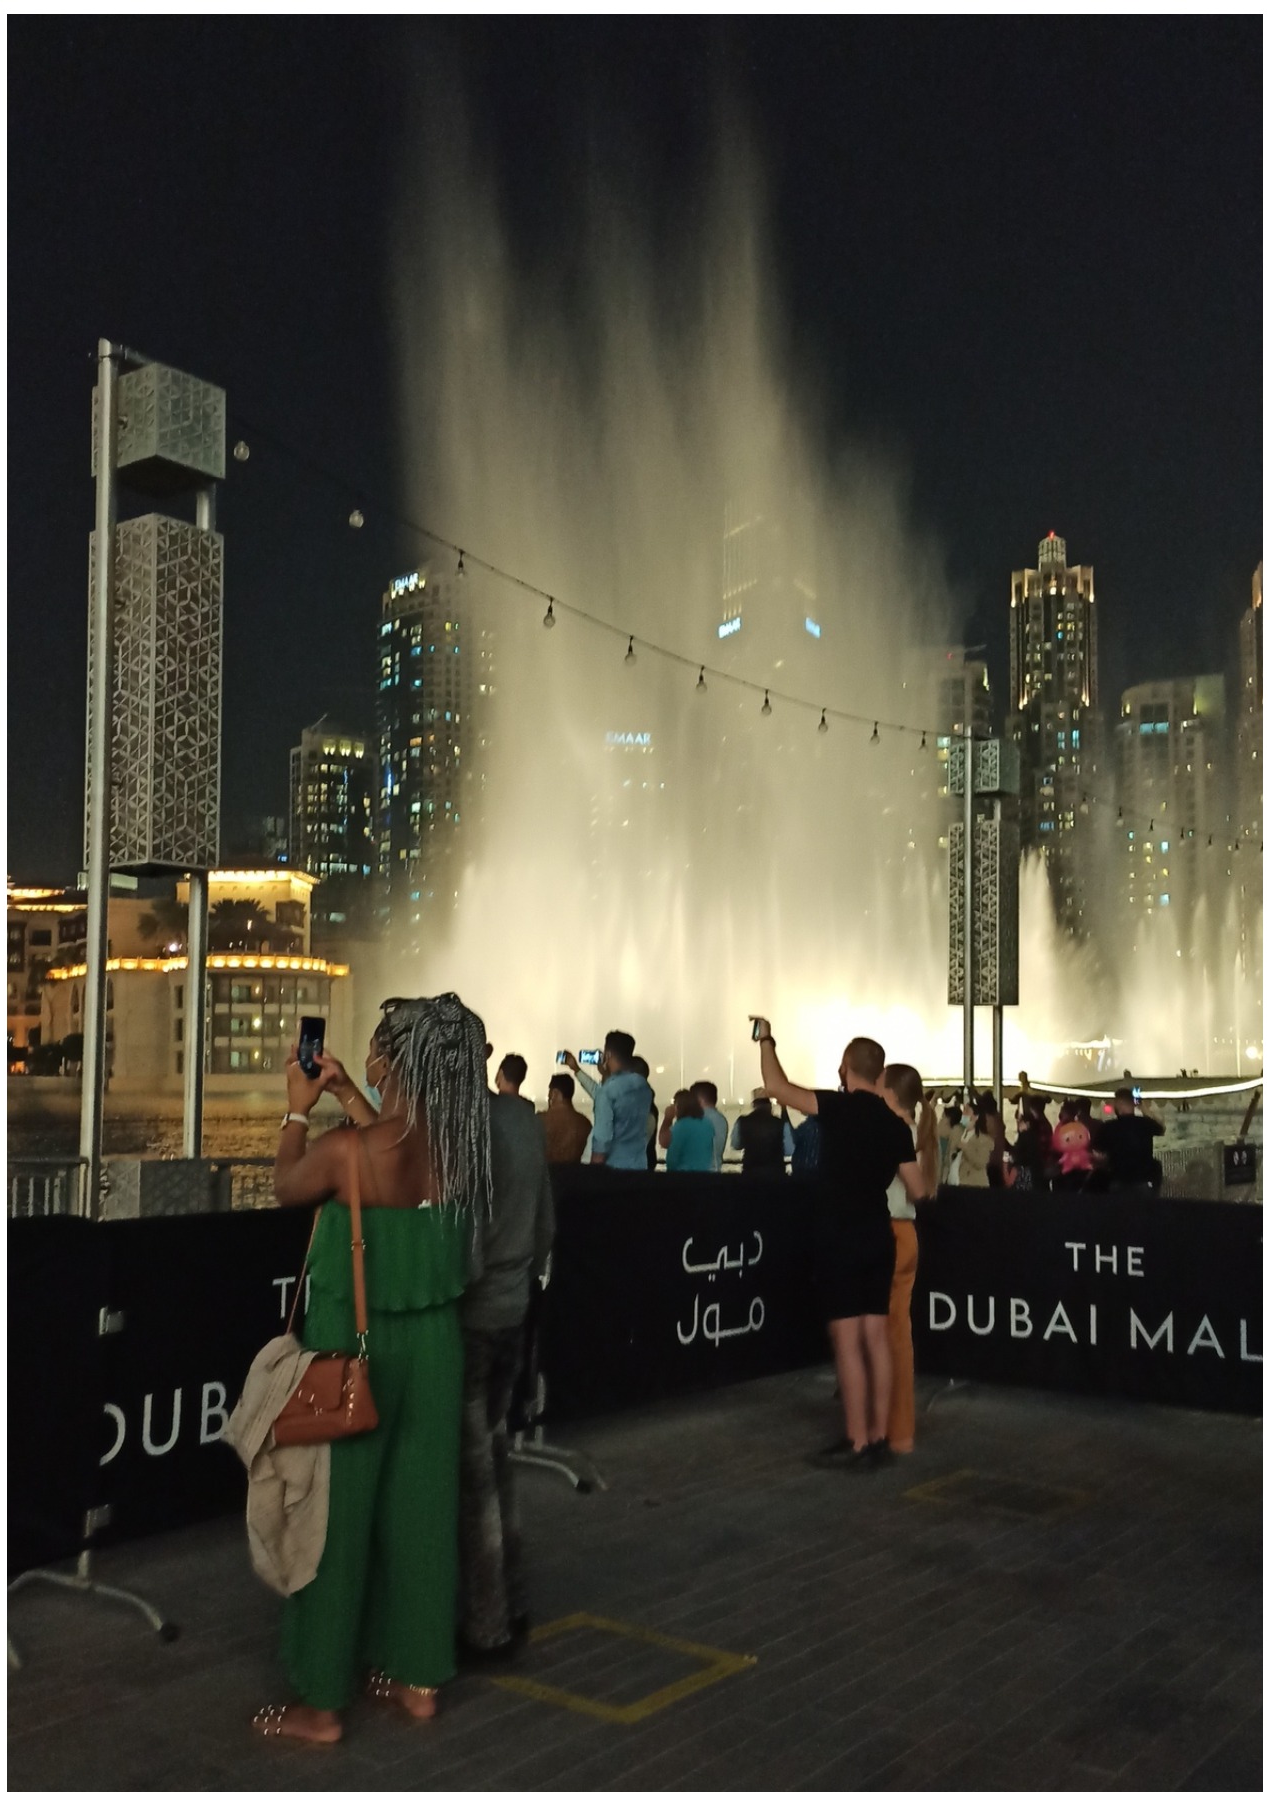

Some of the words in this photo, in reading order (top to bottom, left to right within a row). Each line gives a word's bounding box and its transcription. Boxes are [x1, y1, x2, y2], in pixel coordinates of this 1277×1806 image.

[682, 1230, 763, 1282] دبي
[1064, 1241, 1145, 1278] THE
[676, 1293, 765, 1348] مول
[929, 1290, 1097, 1346] DUBAI
